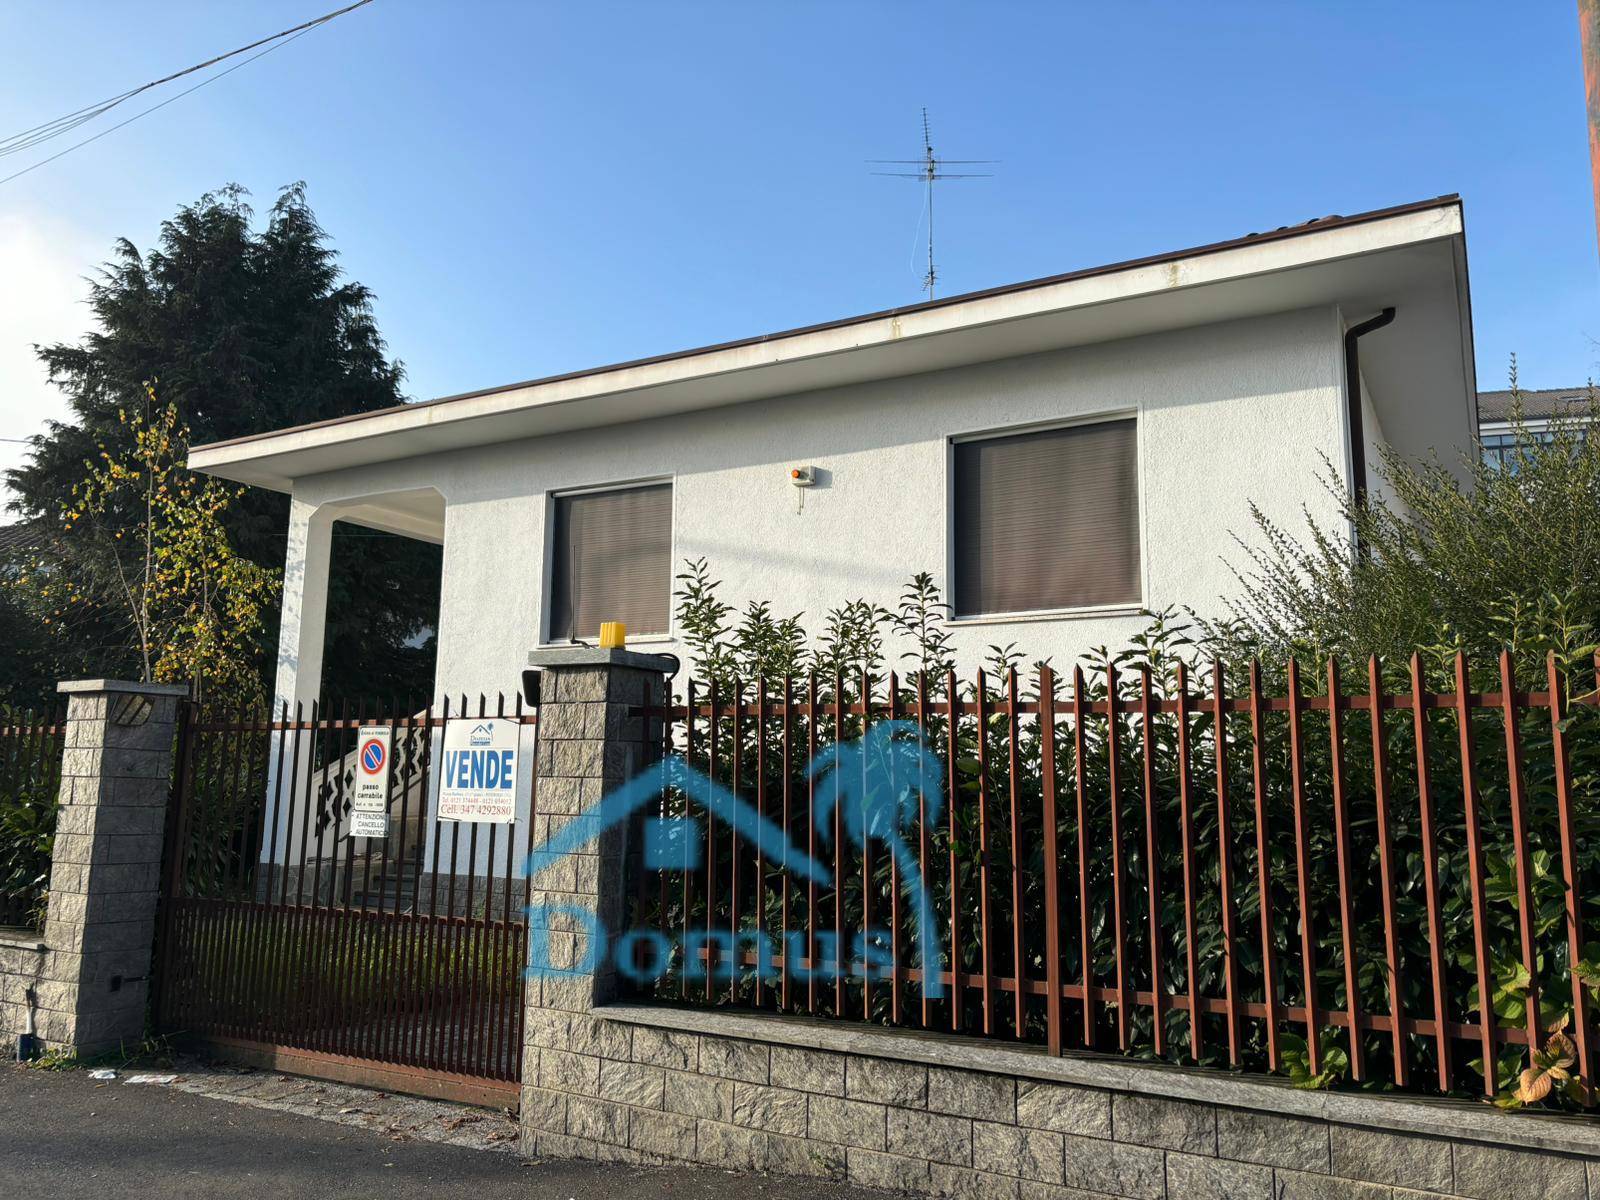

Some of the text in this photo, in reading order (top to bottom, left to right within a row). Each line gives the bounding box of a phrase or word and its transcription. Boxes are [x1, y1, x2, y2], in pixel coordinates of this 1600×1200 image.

[446, 750, 514, 789] VENDE
[460, 804, 475, 814] 347
[477, 805, 512, 815] 4292880
